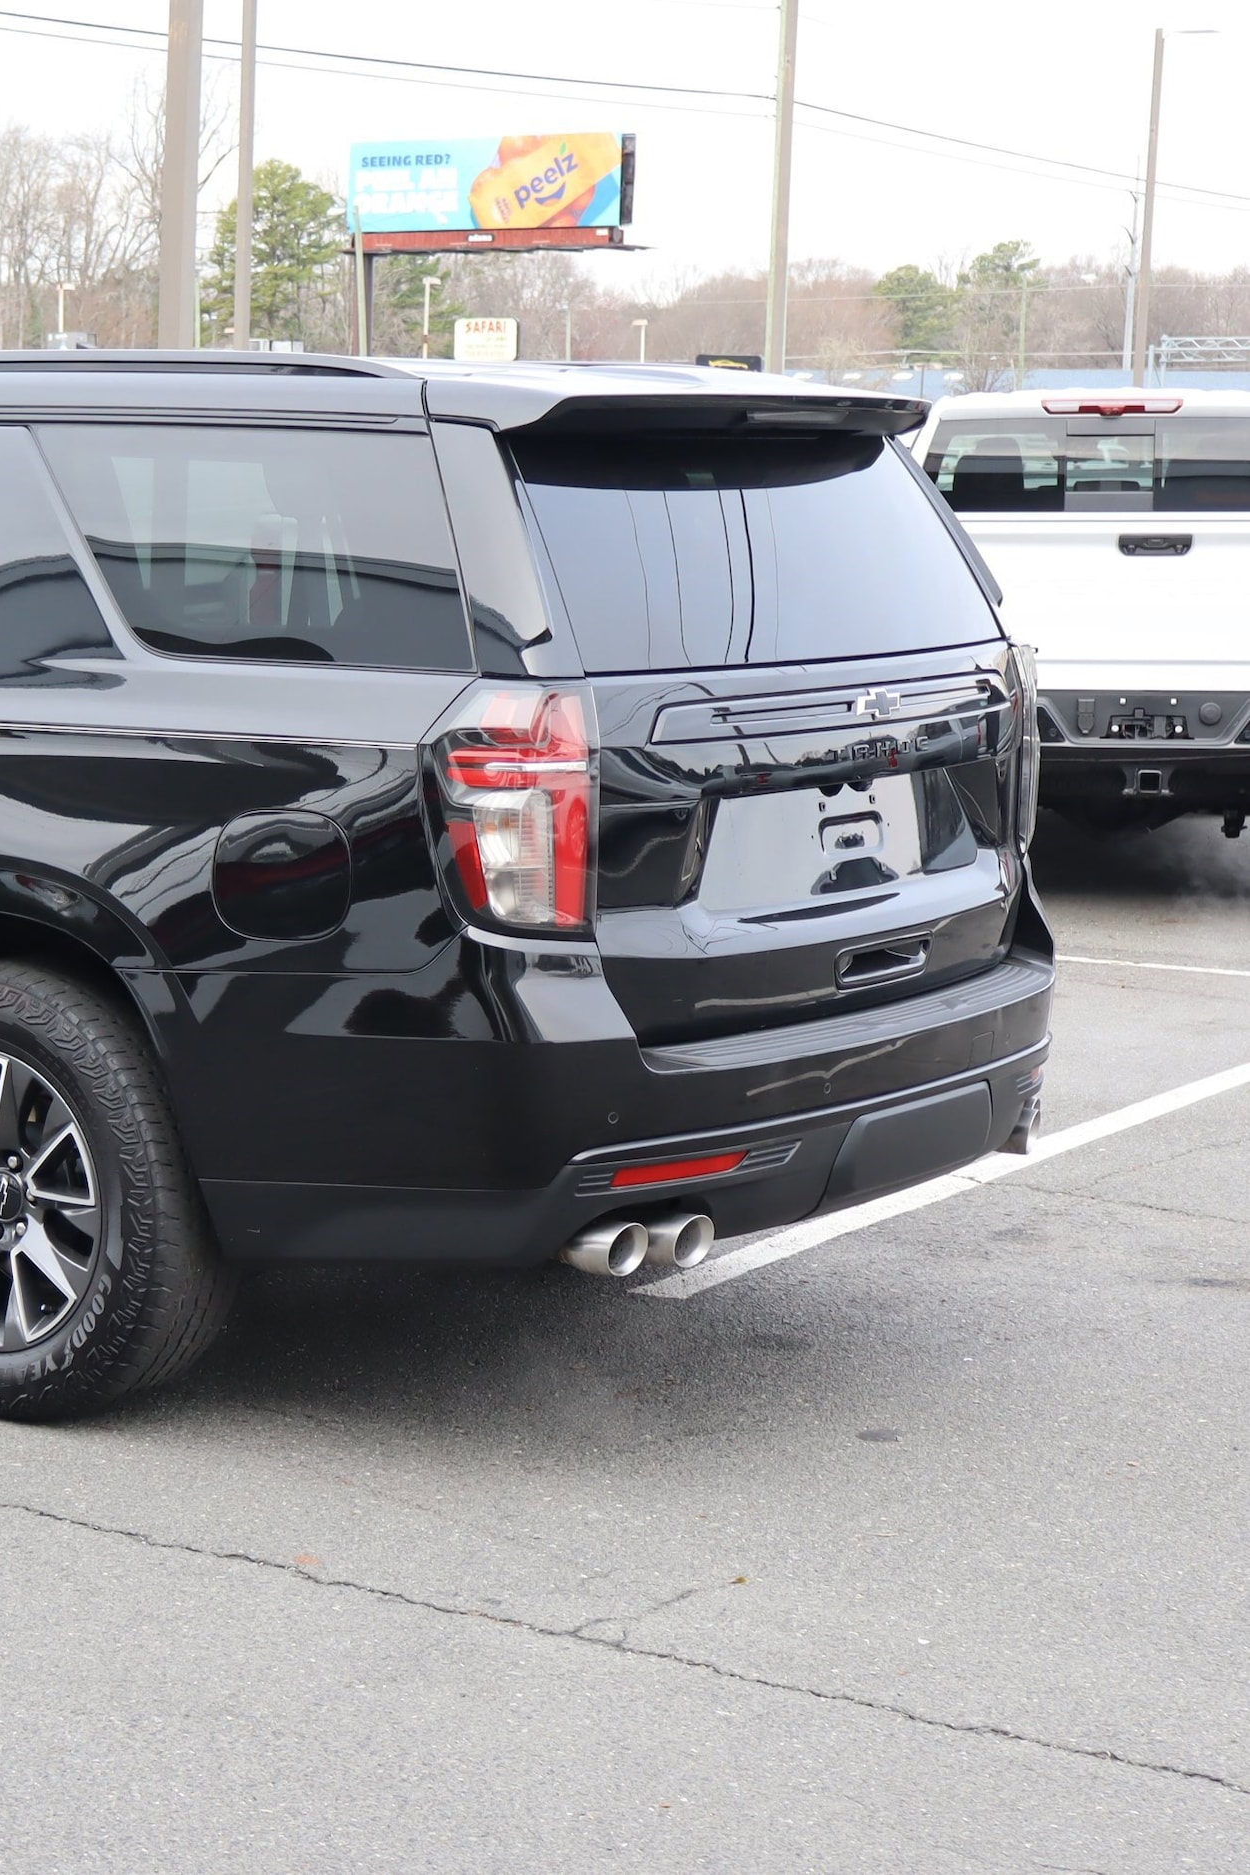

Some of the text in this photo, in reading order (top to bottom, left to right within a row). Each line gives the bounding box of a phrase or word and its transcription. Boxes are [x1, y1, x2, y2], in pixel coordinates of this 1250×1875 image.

[361, 153, 452, 168] SEEING RED?
[513, 153, 579, 210] peelz
[465, 319, 507, 334] SAFARI
[827, 736, 929, 762] TAHOE
